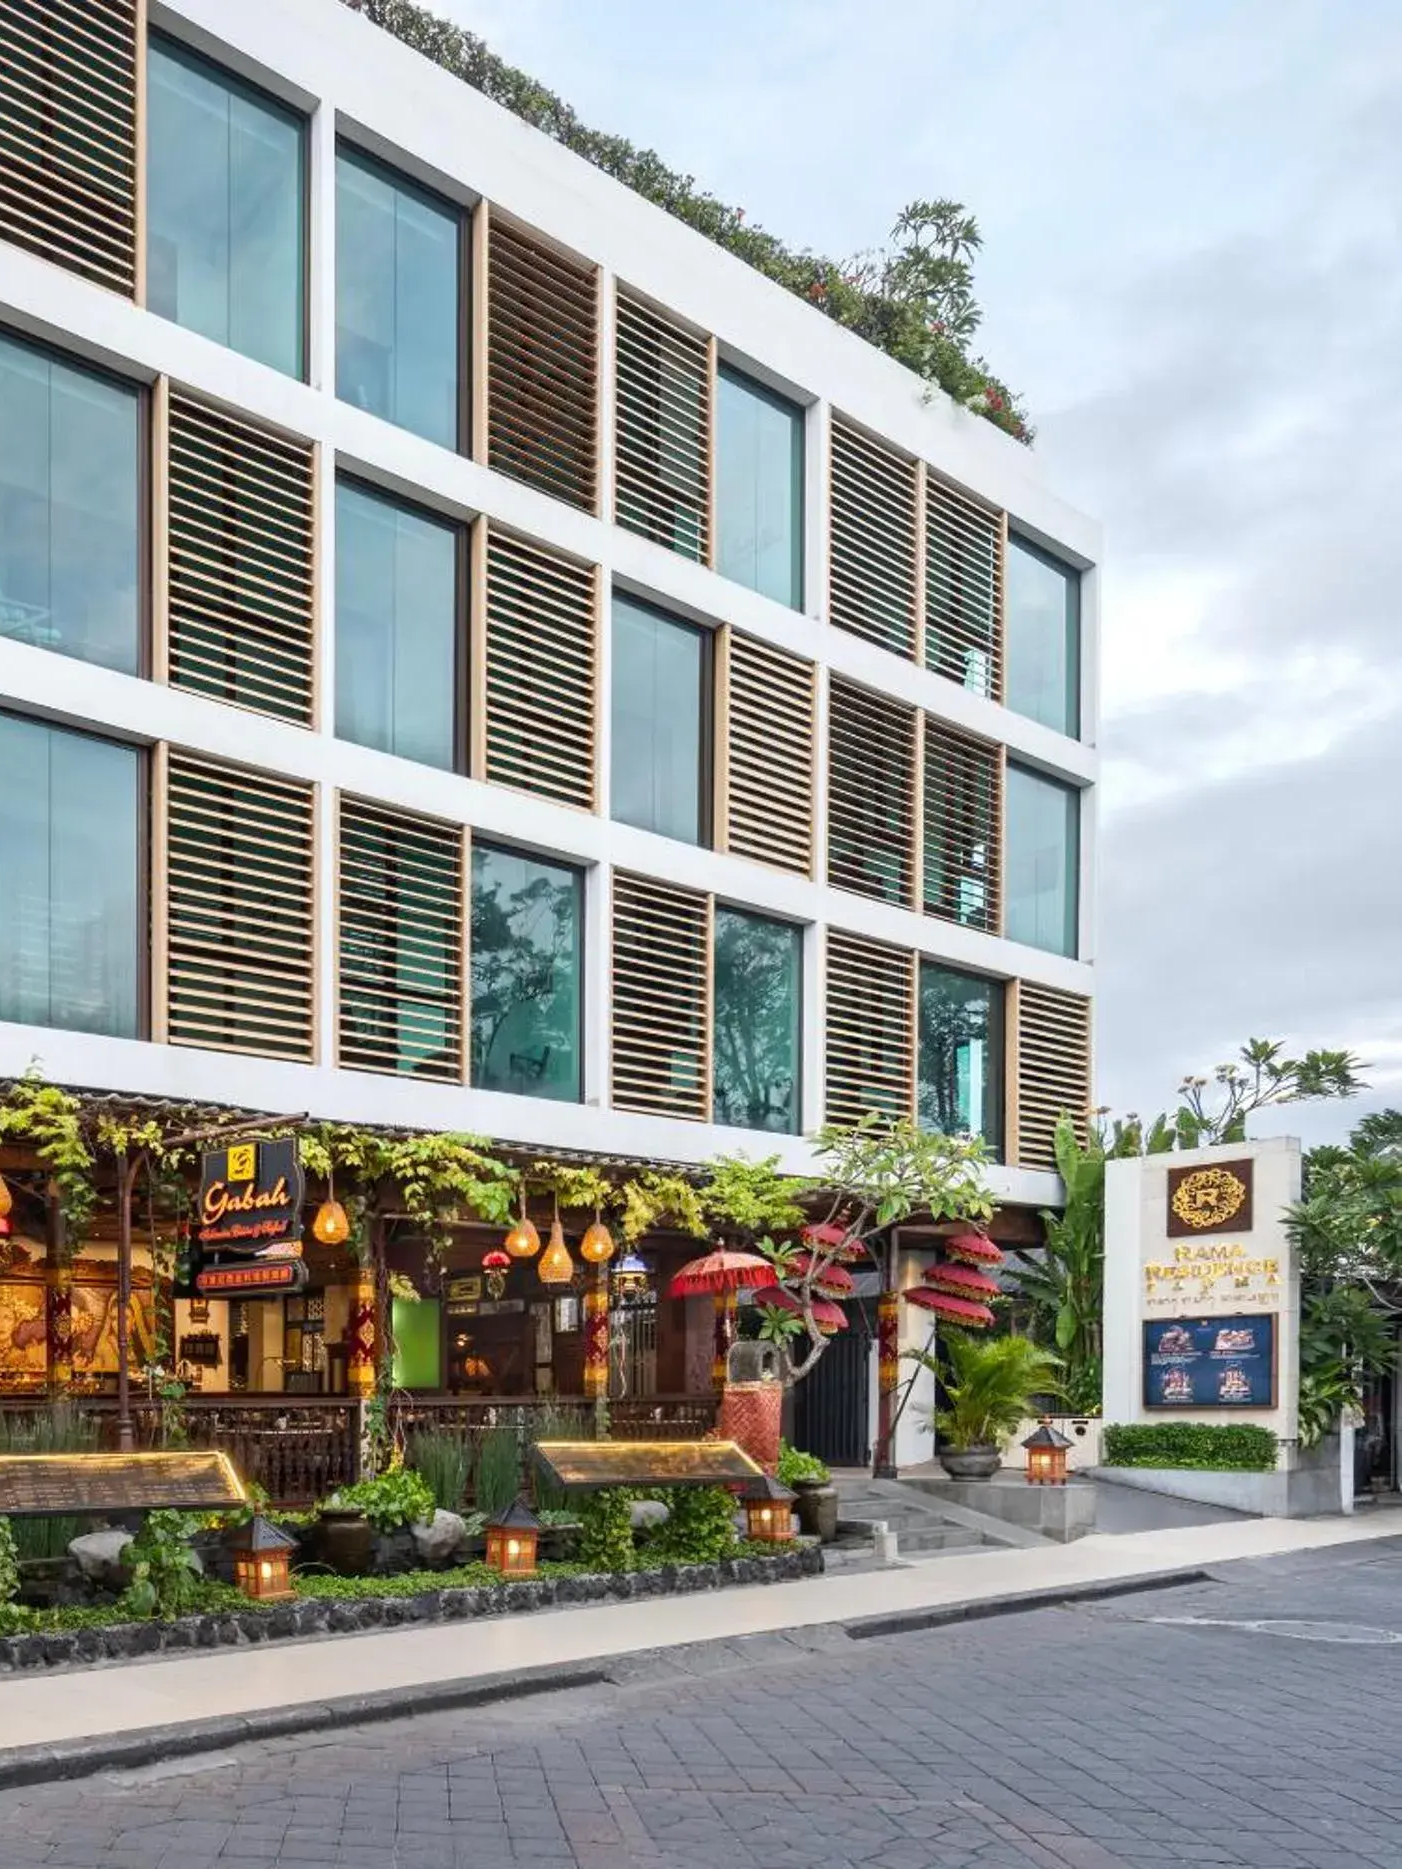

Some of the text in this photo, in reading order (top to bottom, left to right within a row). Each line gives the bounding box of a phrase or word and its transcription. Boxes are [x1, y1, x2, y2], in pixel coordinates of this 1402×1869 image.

[201, 1175, 291, 1225] Gabah
[1195, 1188, 1219, 1208] R
[1174, 1242, 1246, 1261] RAMA
